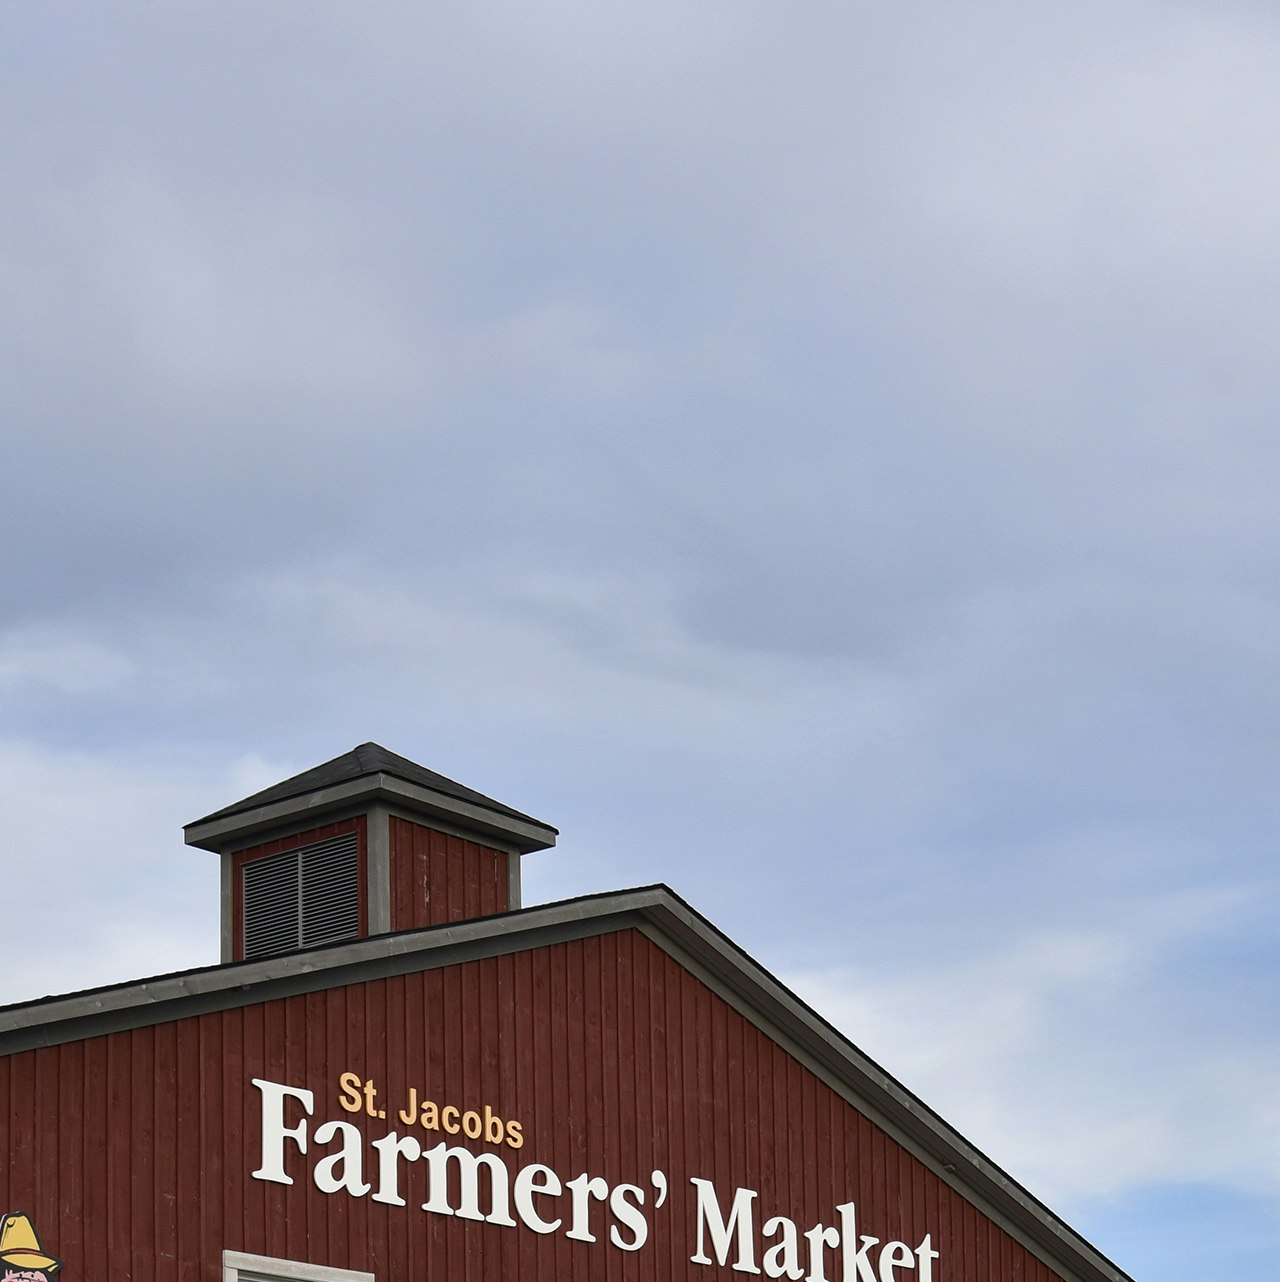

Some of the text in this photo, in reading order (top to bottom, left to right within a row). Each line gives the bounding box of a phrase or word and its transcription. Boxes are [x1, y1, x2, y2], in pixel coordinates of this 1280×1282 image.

[251, 1078, 669, 1253] Farmers'
[338, 1072, 525, 1149] St. Jacobs
